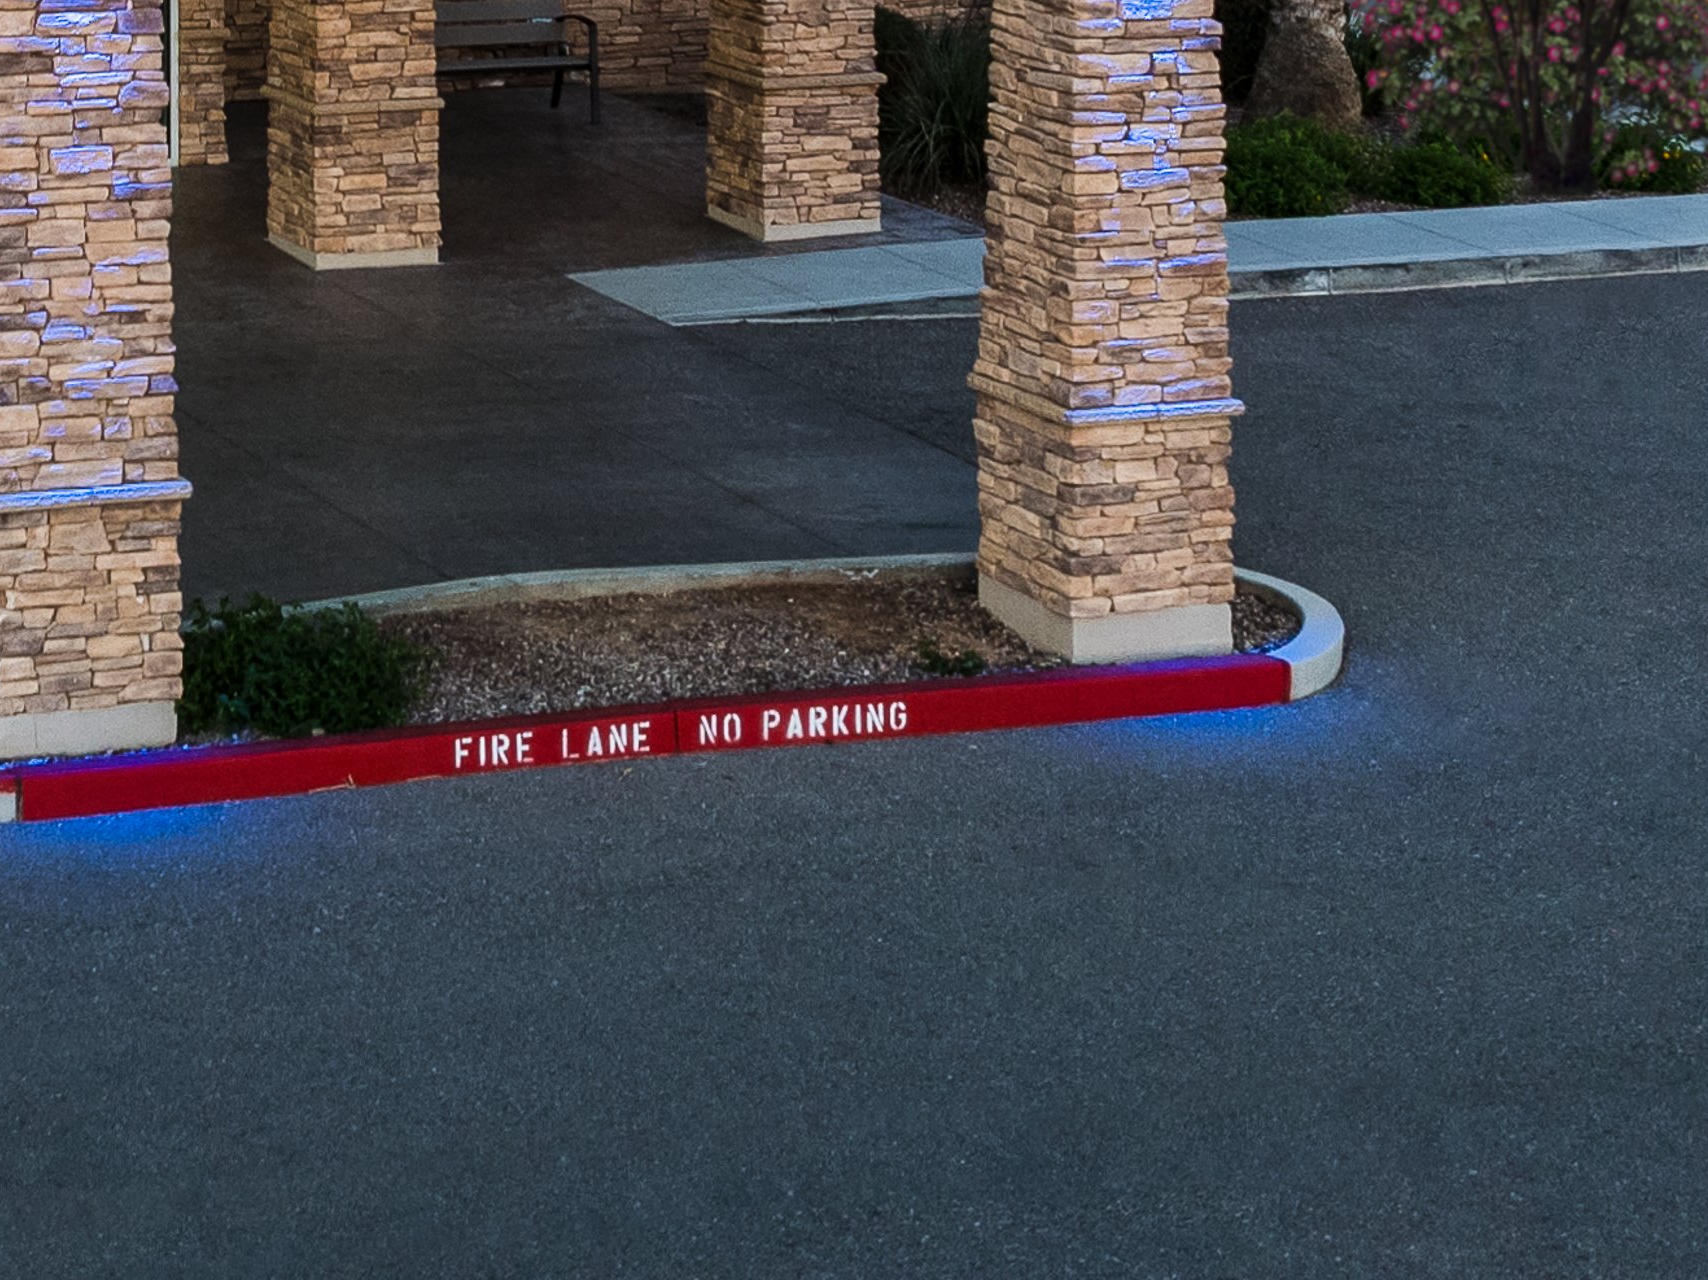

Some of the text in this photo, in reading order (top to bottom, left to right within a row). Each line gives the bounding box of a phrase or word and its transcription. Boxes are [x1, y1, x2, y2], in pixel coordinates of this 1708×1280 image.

[454, 701, 908, 769] FIRE LANE NO PARKING
